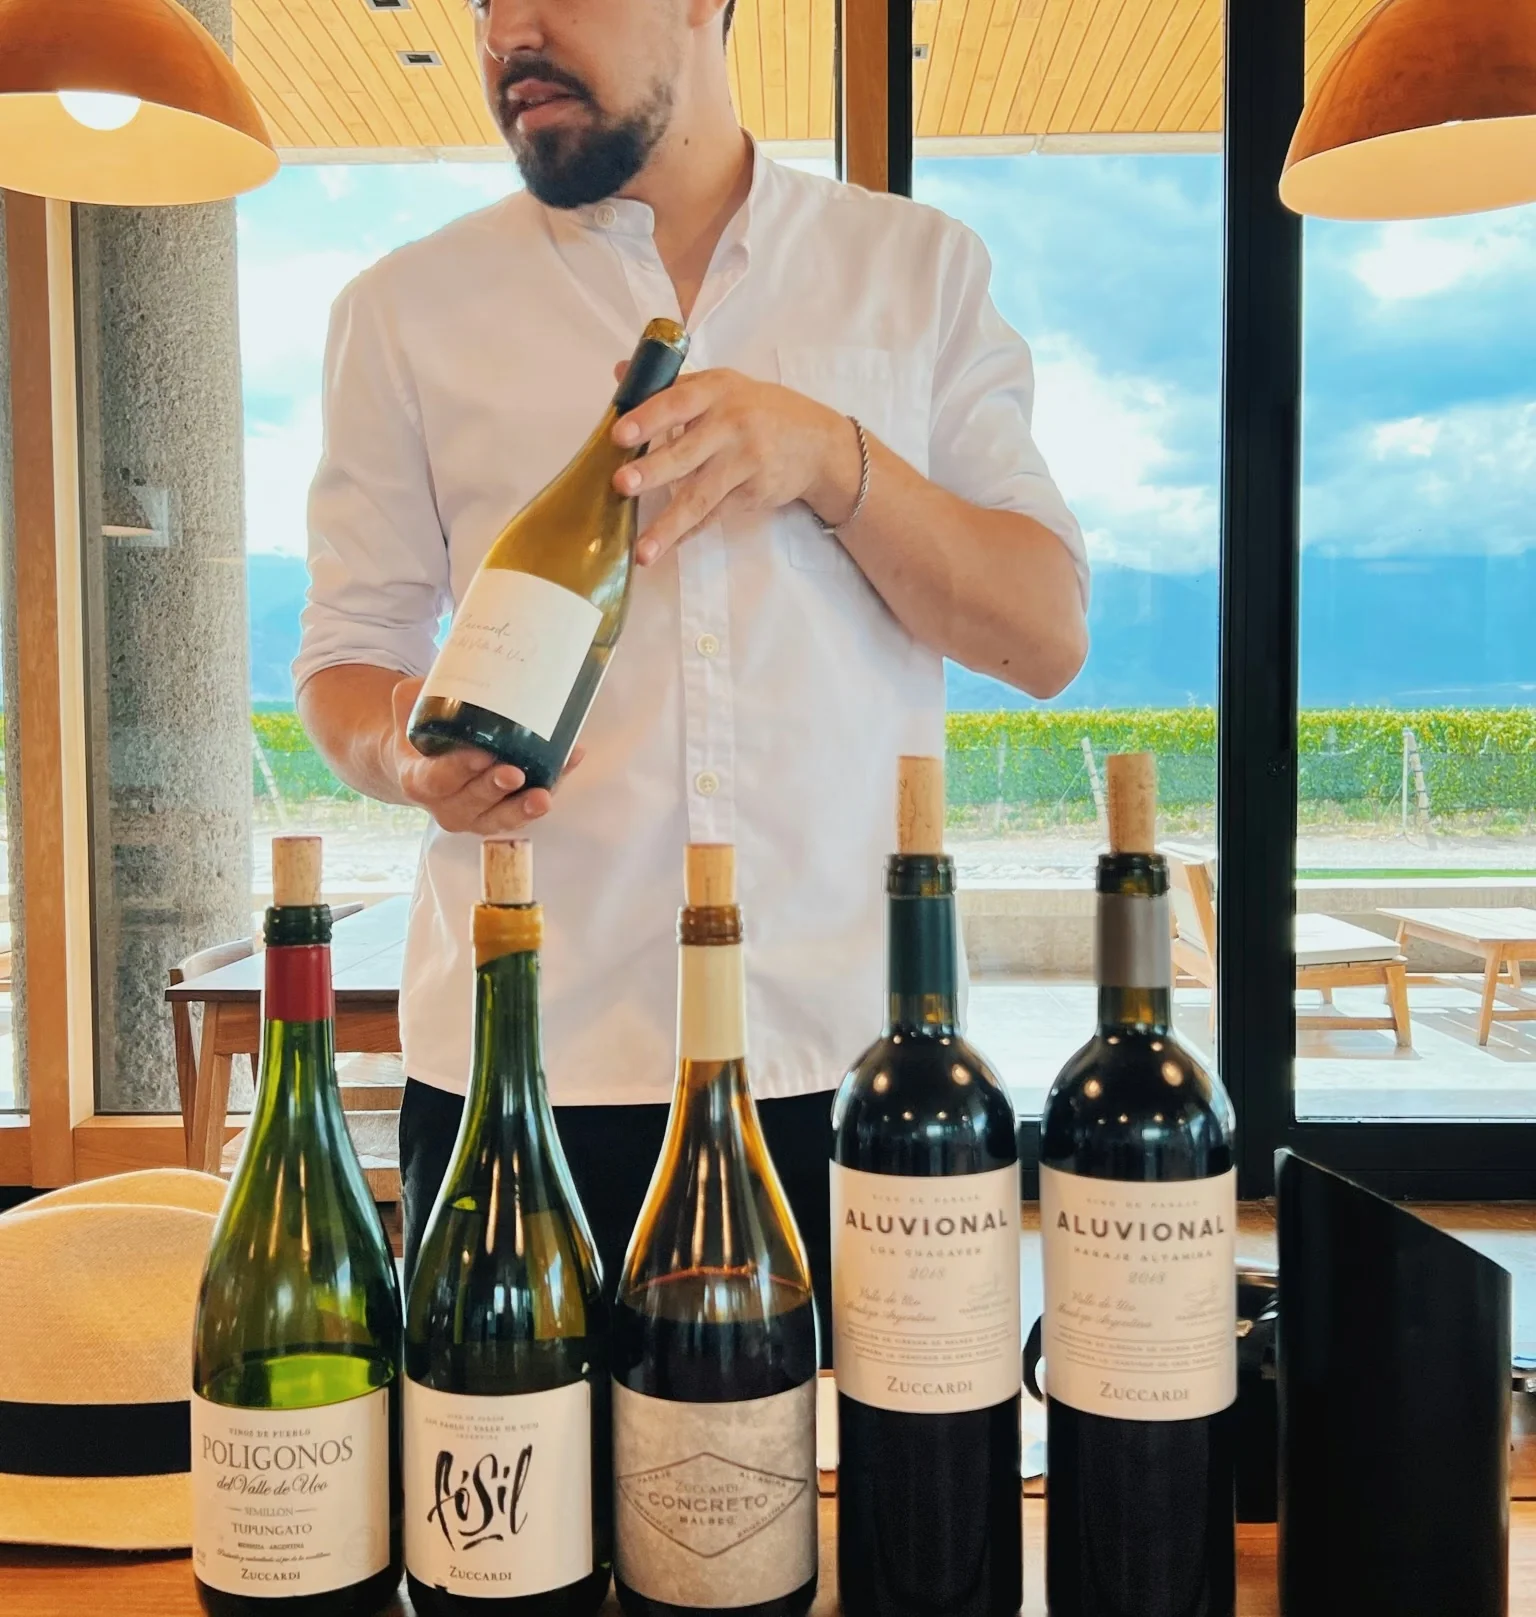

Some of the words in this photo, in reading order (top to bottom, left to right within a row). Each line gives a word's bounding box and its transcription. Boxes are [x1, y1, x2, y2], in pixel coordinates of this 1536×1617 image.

[845, 1208, 1008, 1236] ALUVIONAL
[1057, 1210, 1225, 1242] ALUVIONAL
[1140, 1249, 1213, 1263] ALTAMIRA
[886, 1375, 973, 1395] ZUCCARDI
[1099, 1381, 1190, 1401] ZUCCARDI
[256, 1429, 269, 1438] DE
[202, 1435, 354, 1471] POLIGONOS
[217, 1475, 234, 1491] del
[233, 1473, 272, 1496] Valle
[273, 1480, 291, 1496] de
[291, 1473, 329, 1495] Uco
[648, 1491, 769, 1513] CONCRETO
[232, 1521, 313, 1536] TUPUNGATO
[679, 1515, 735, 1526] MALBEC
[241, 1568, 301, 1582] ZUCCARDI
[449, 1565, 512, 1582] ZUCCARDI
